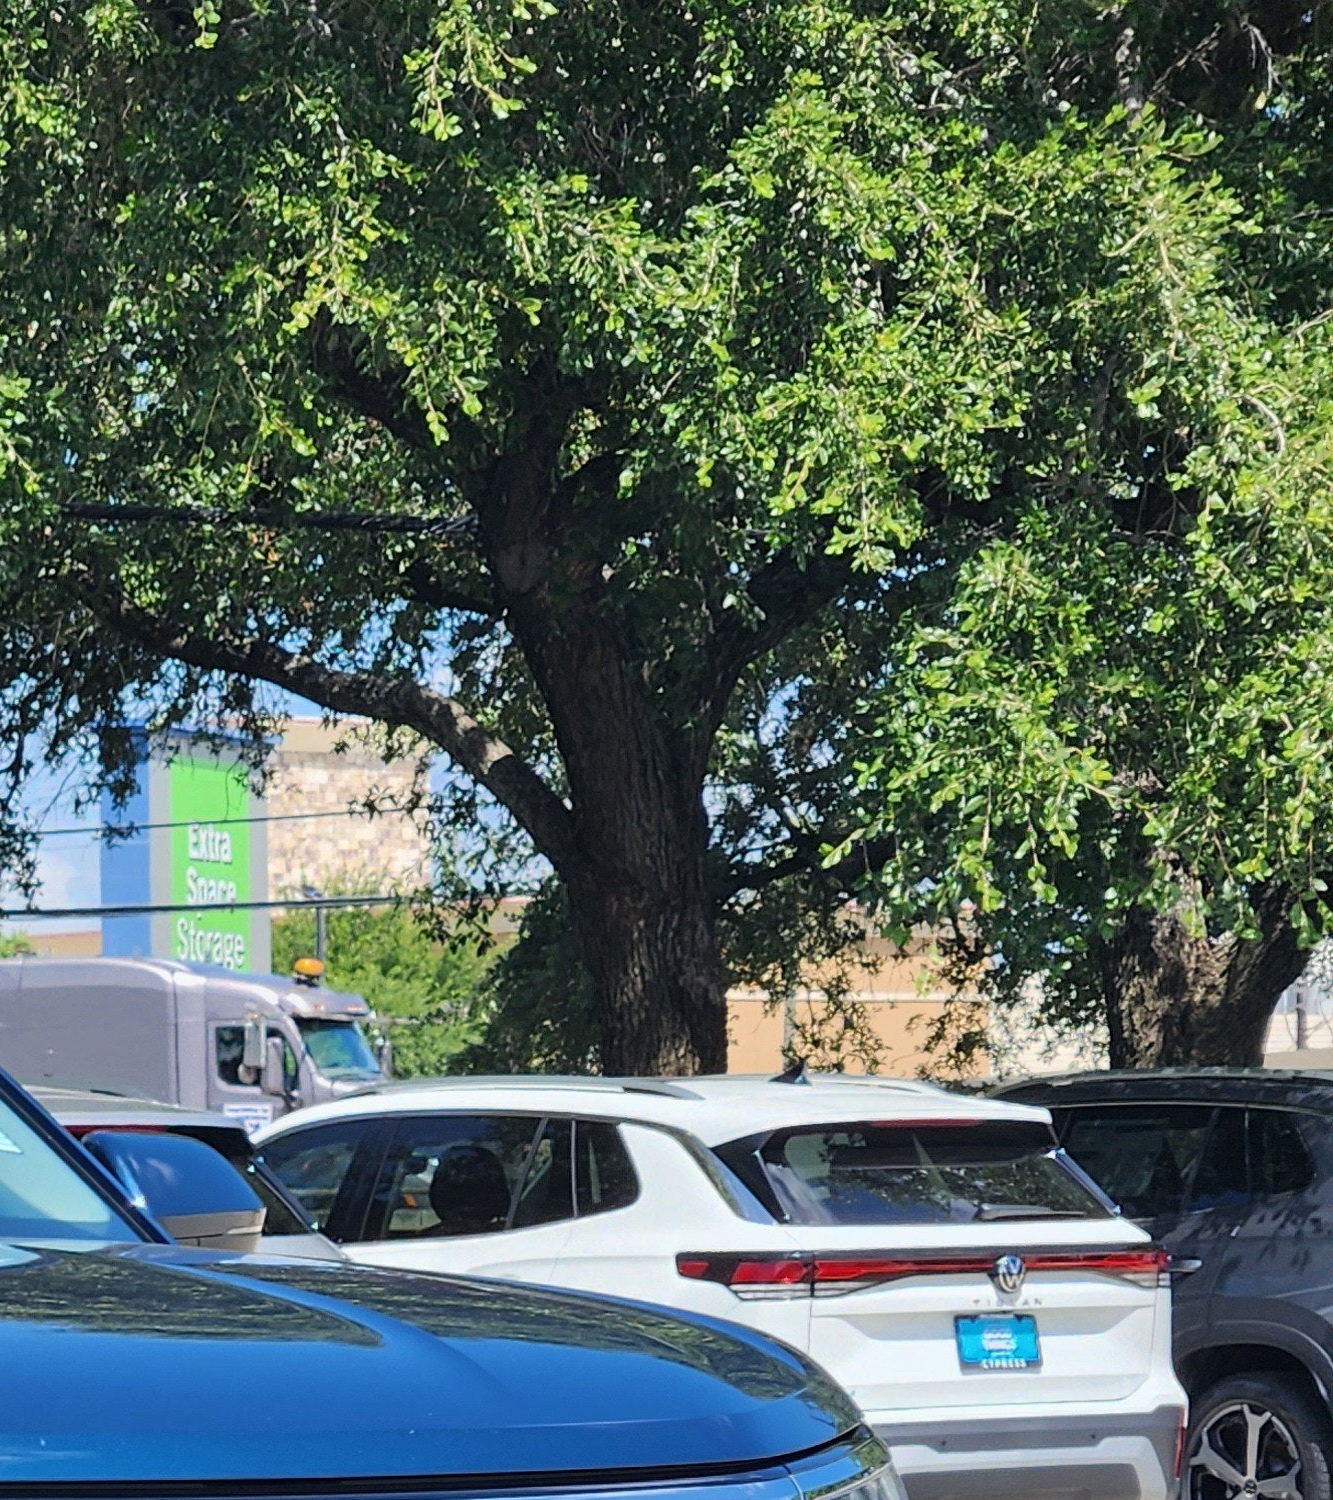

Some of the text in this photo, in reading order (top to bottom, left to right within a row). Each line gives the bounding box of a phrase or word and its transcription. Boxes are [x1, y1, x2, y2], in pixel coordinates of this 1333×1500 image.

[188, 822, 232, 862] Extra
[186, 866, 237, 912] Space
[177, 918, 246, 969] Storage
